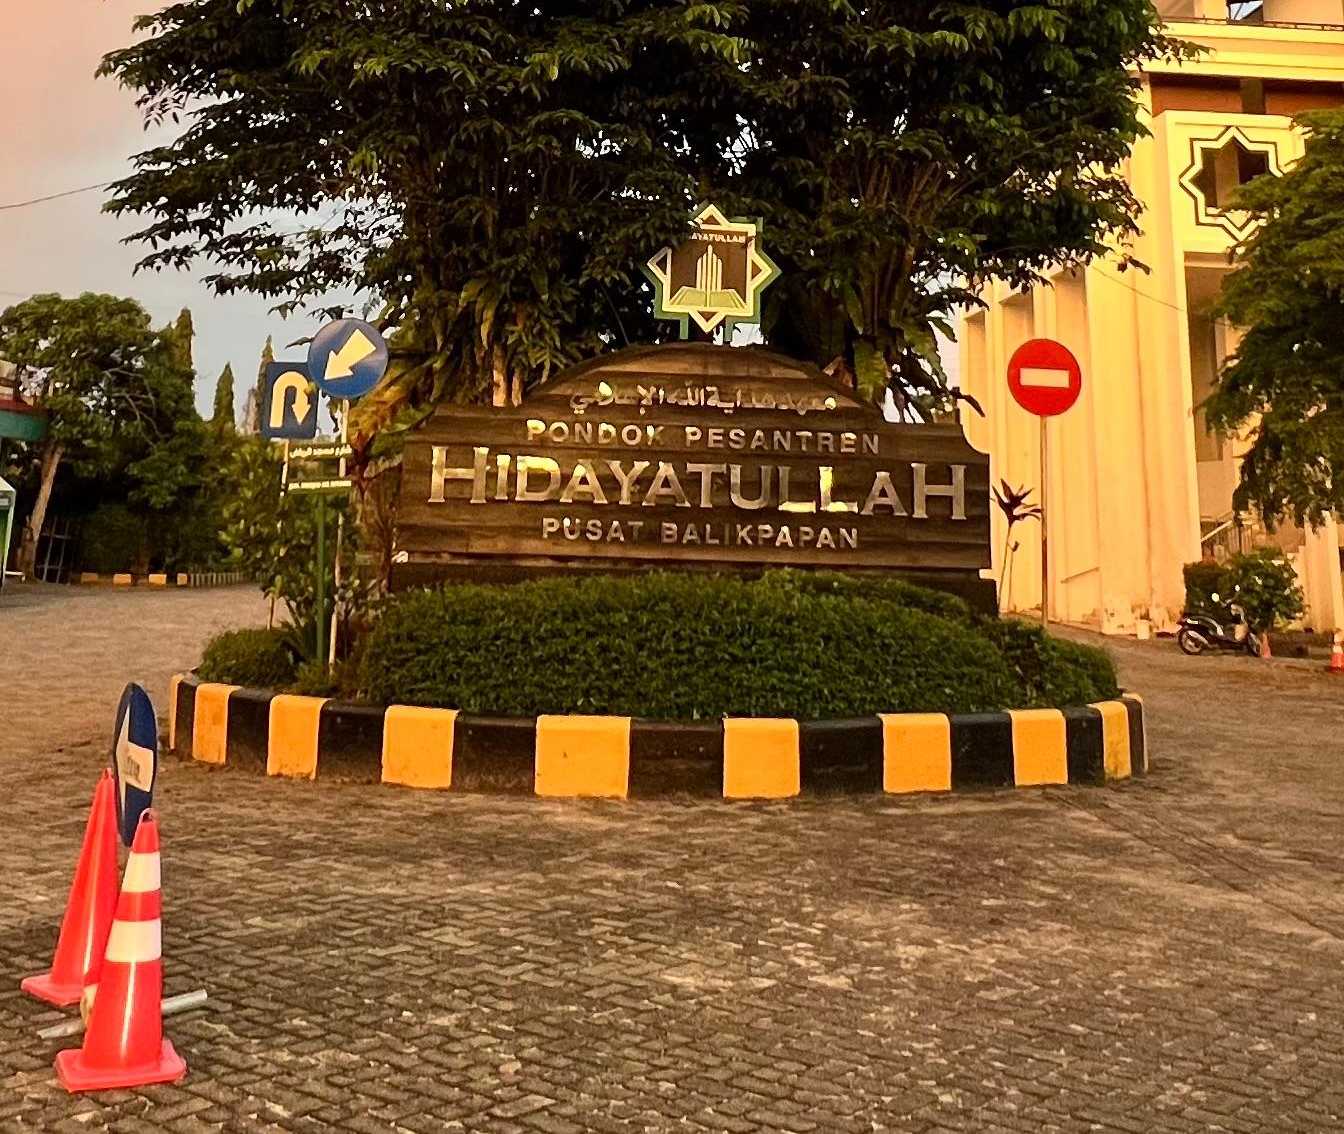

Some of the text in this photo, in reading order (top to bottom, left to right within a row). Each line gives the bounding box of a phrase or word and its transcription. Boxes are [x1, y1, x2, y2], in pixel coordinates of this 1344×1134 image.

[526, 419, 880, 455] PONDOK PESANTREN
[426, 444, 968, 521] HIDAYATULLAH
[541, 517, 859, 550] PUSAT BALIKPAPAN
